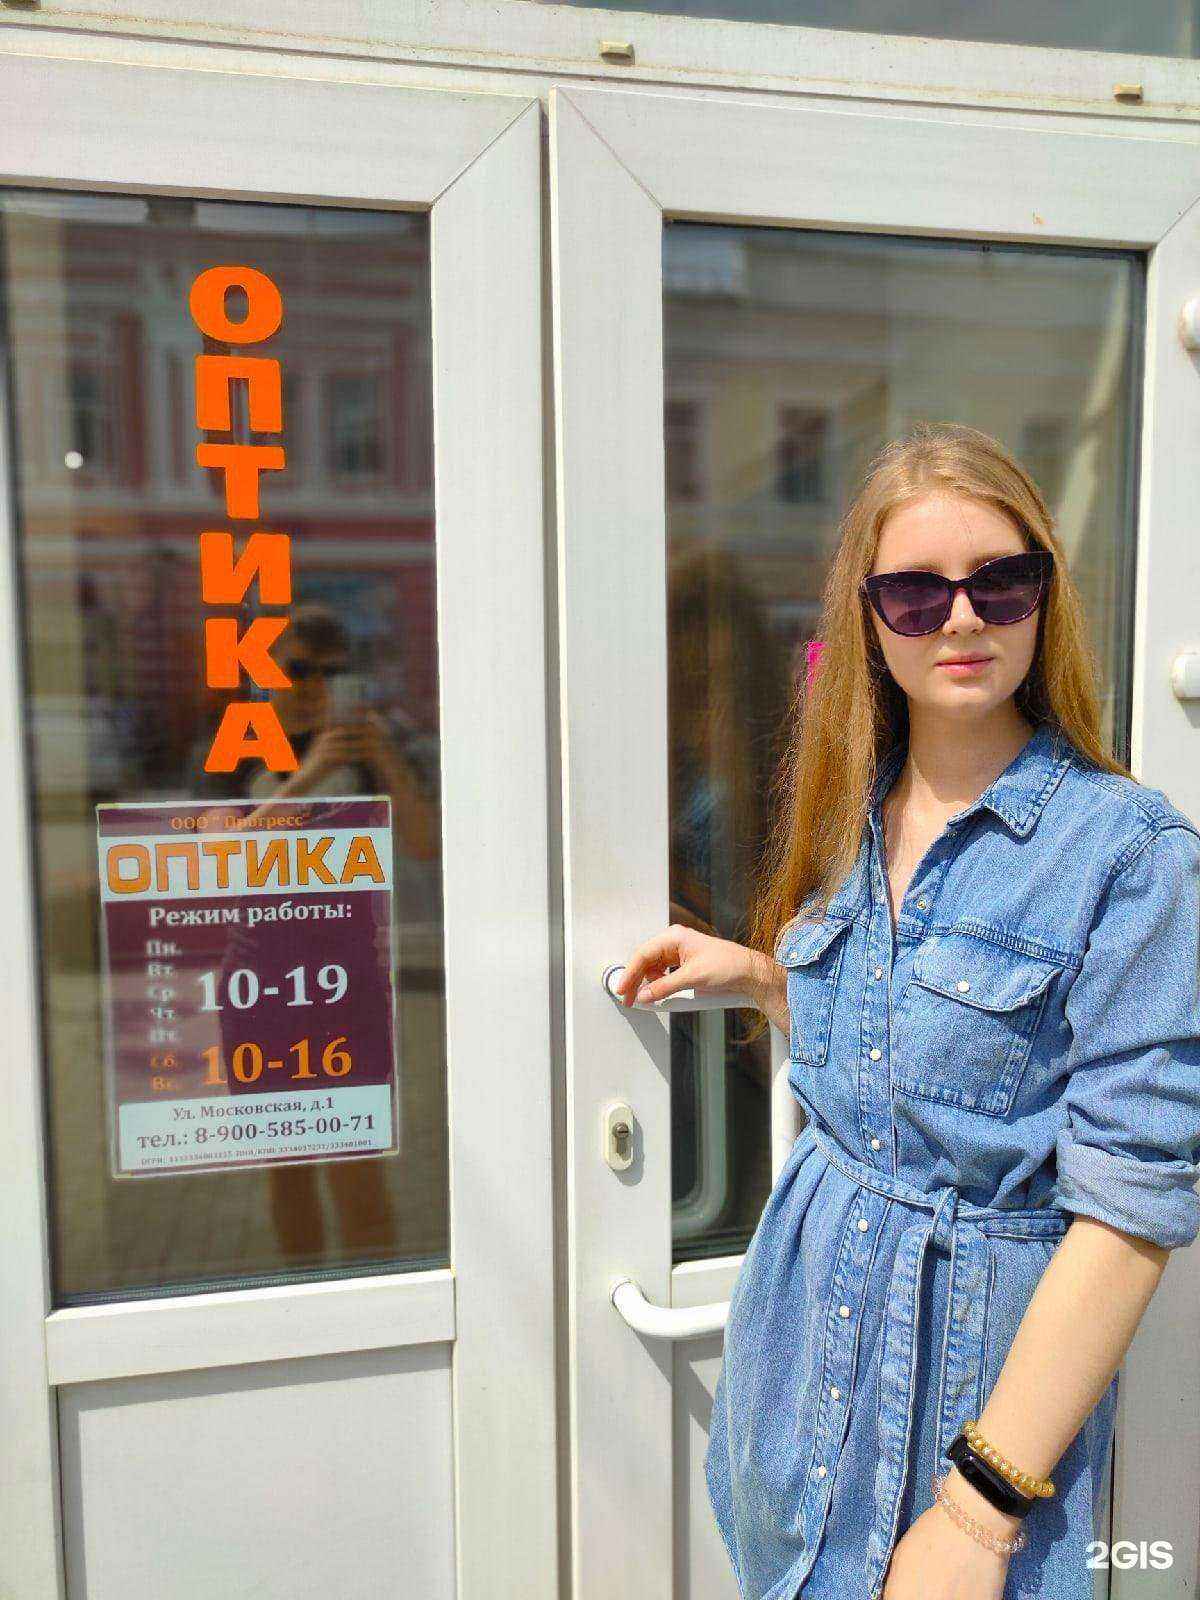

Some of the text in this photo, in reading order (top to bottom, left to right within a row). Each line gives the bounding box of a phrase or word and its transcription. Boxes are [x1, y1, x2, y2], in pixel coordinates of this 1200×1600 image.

[189, 266, 300, 772] ОПТИКА
[170, 816, 209, 831] ООО
[107, 836, 386, 894] ОПТИКА
[149, 900, 352, 927] Режим работы:
[198, 964, 349, 1011] 10-19
[203, 1036, 352, 1085] 10-16
[173, 1096, 335, 1121] Ул. Московская, д.1
[136, 1113, 376, 1150] тел.: 8-900-585-00-71
